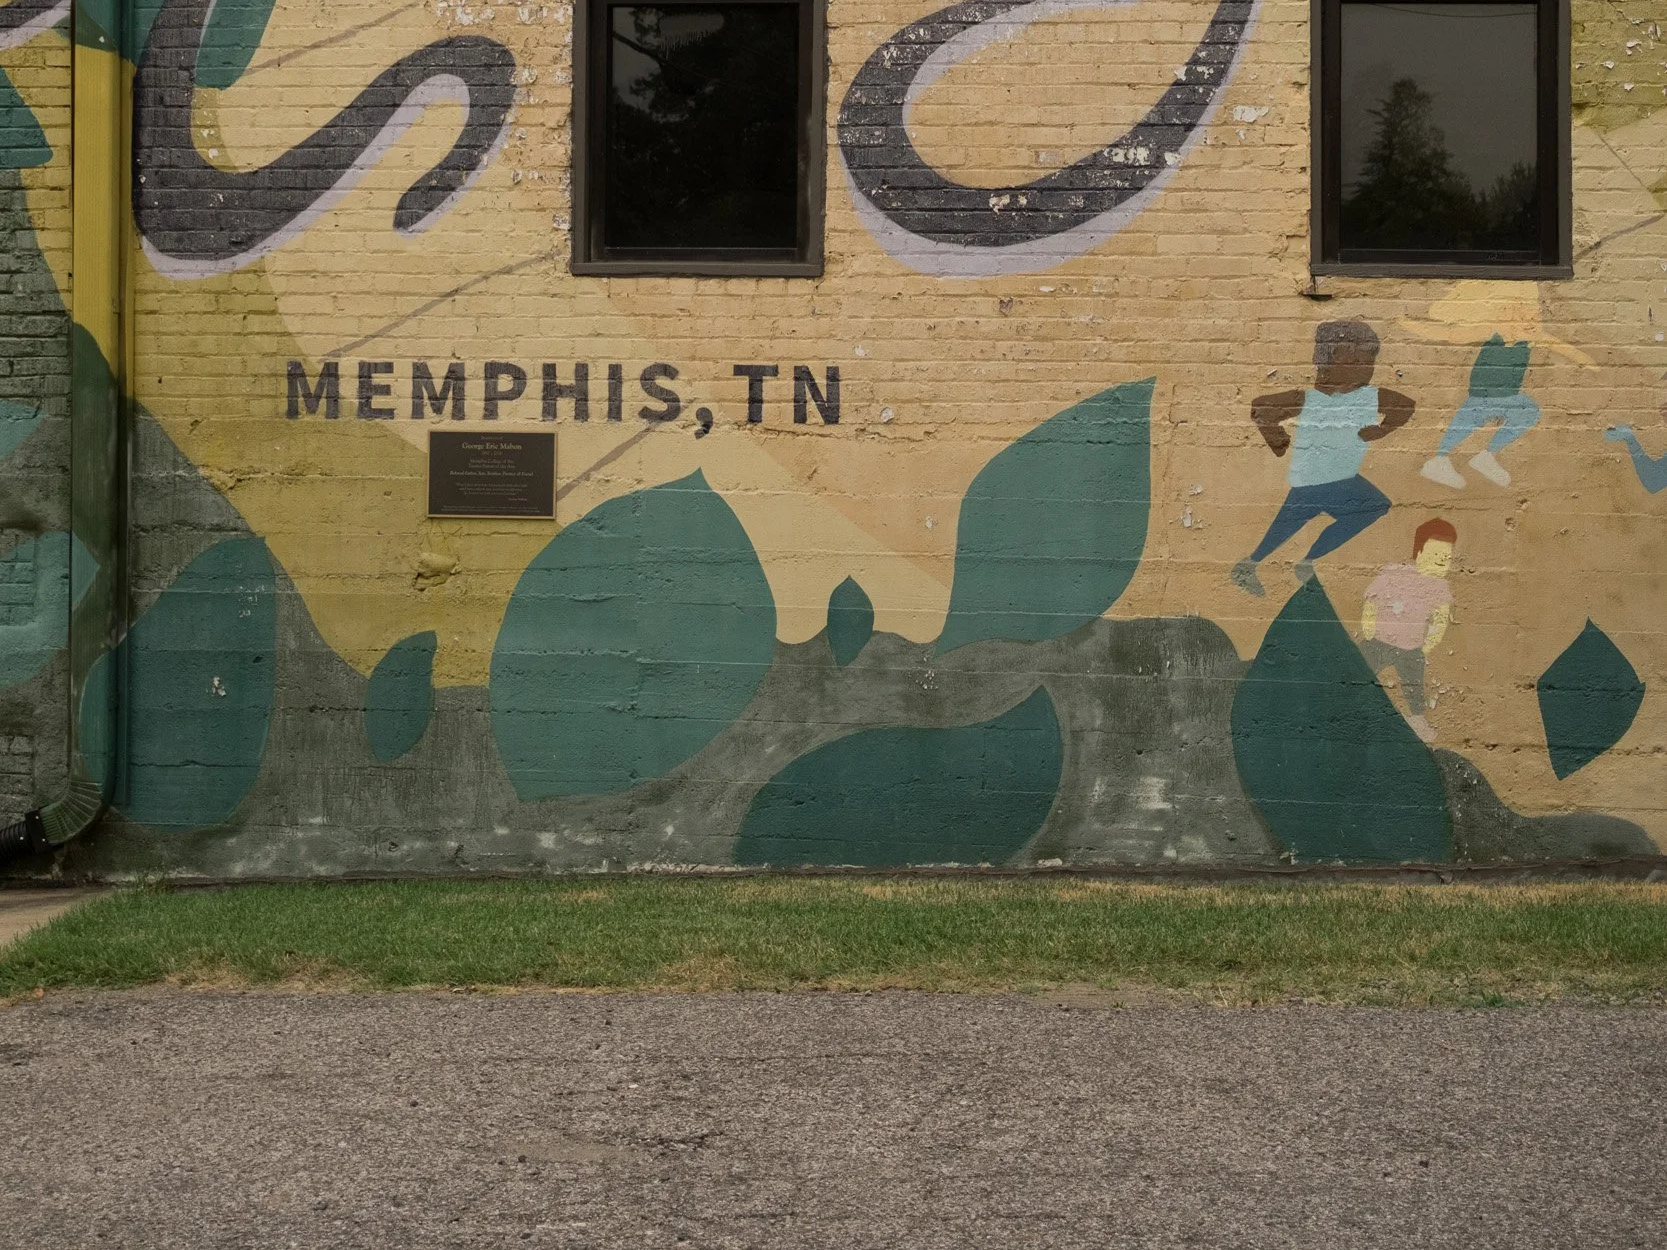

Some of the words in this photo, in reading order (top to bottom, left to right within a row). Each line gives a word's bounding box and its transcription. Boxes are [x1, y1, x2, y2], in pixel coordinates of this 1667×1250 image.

[285, 359, 714, 441] MEMPHIS,
[732, 363, 840, 425] TN
[461, 442, 485, 451] George
[486, 442, 499, 450] Eric
